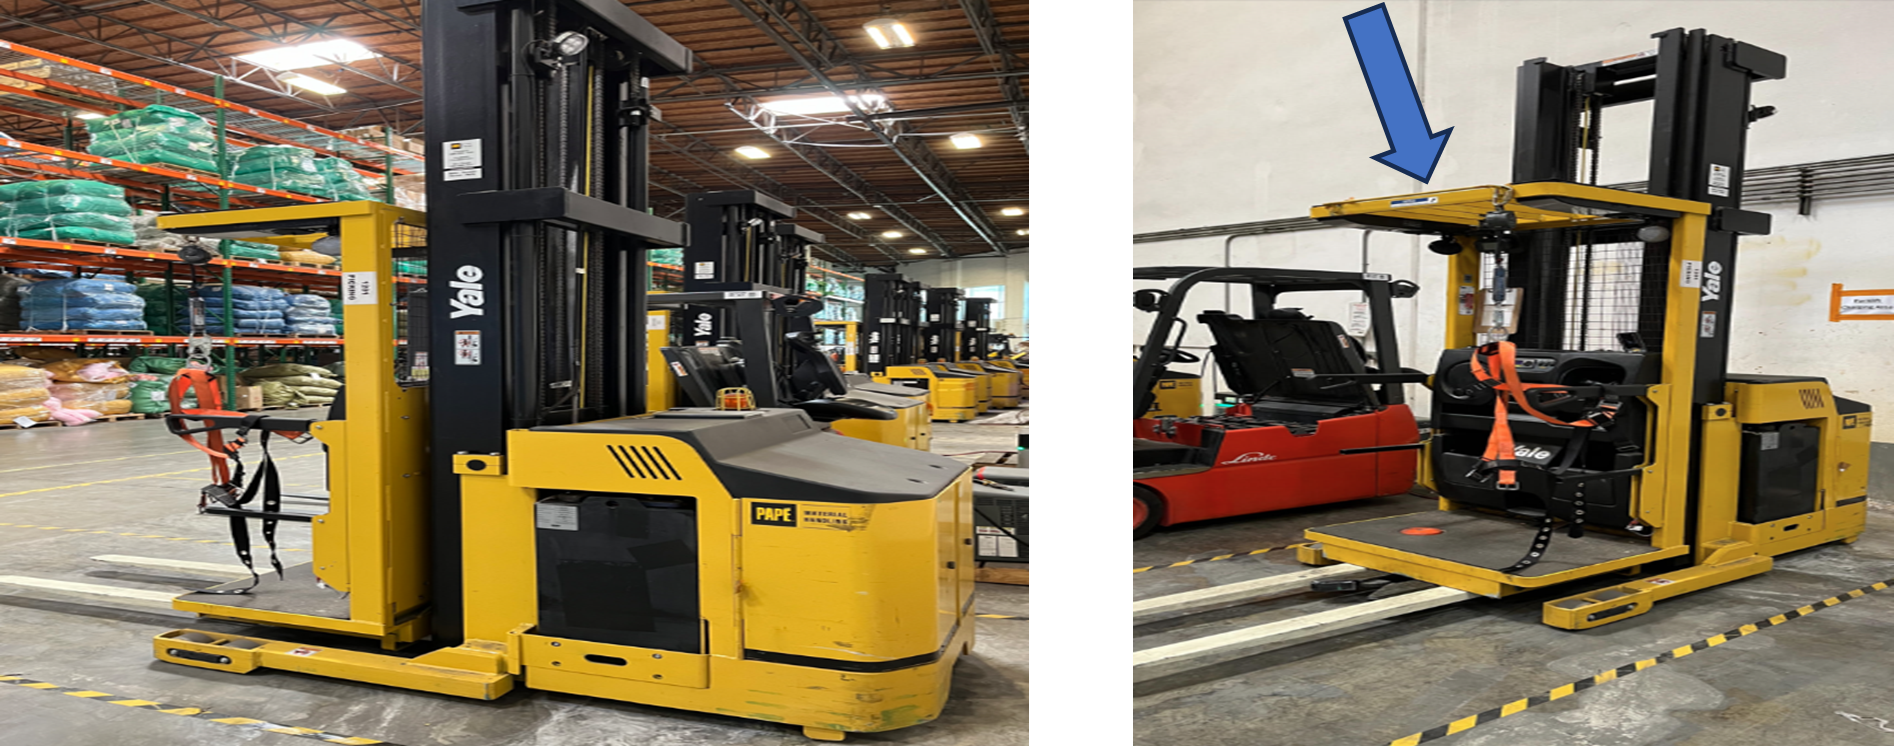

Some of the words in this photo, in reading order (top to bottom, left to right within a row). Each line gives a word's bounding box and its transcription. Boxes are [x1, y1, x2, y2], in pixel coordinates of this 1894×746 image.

[449, 265, 484, 319] Yale
[1701, 261, 1722, 301] Yale
[693, 312, 713, 337] Yale
[1220, 451, 1277, 465] Linde
